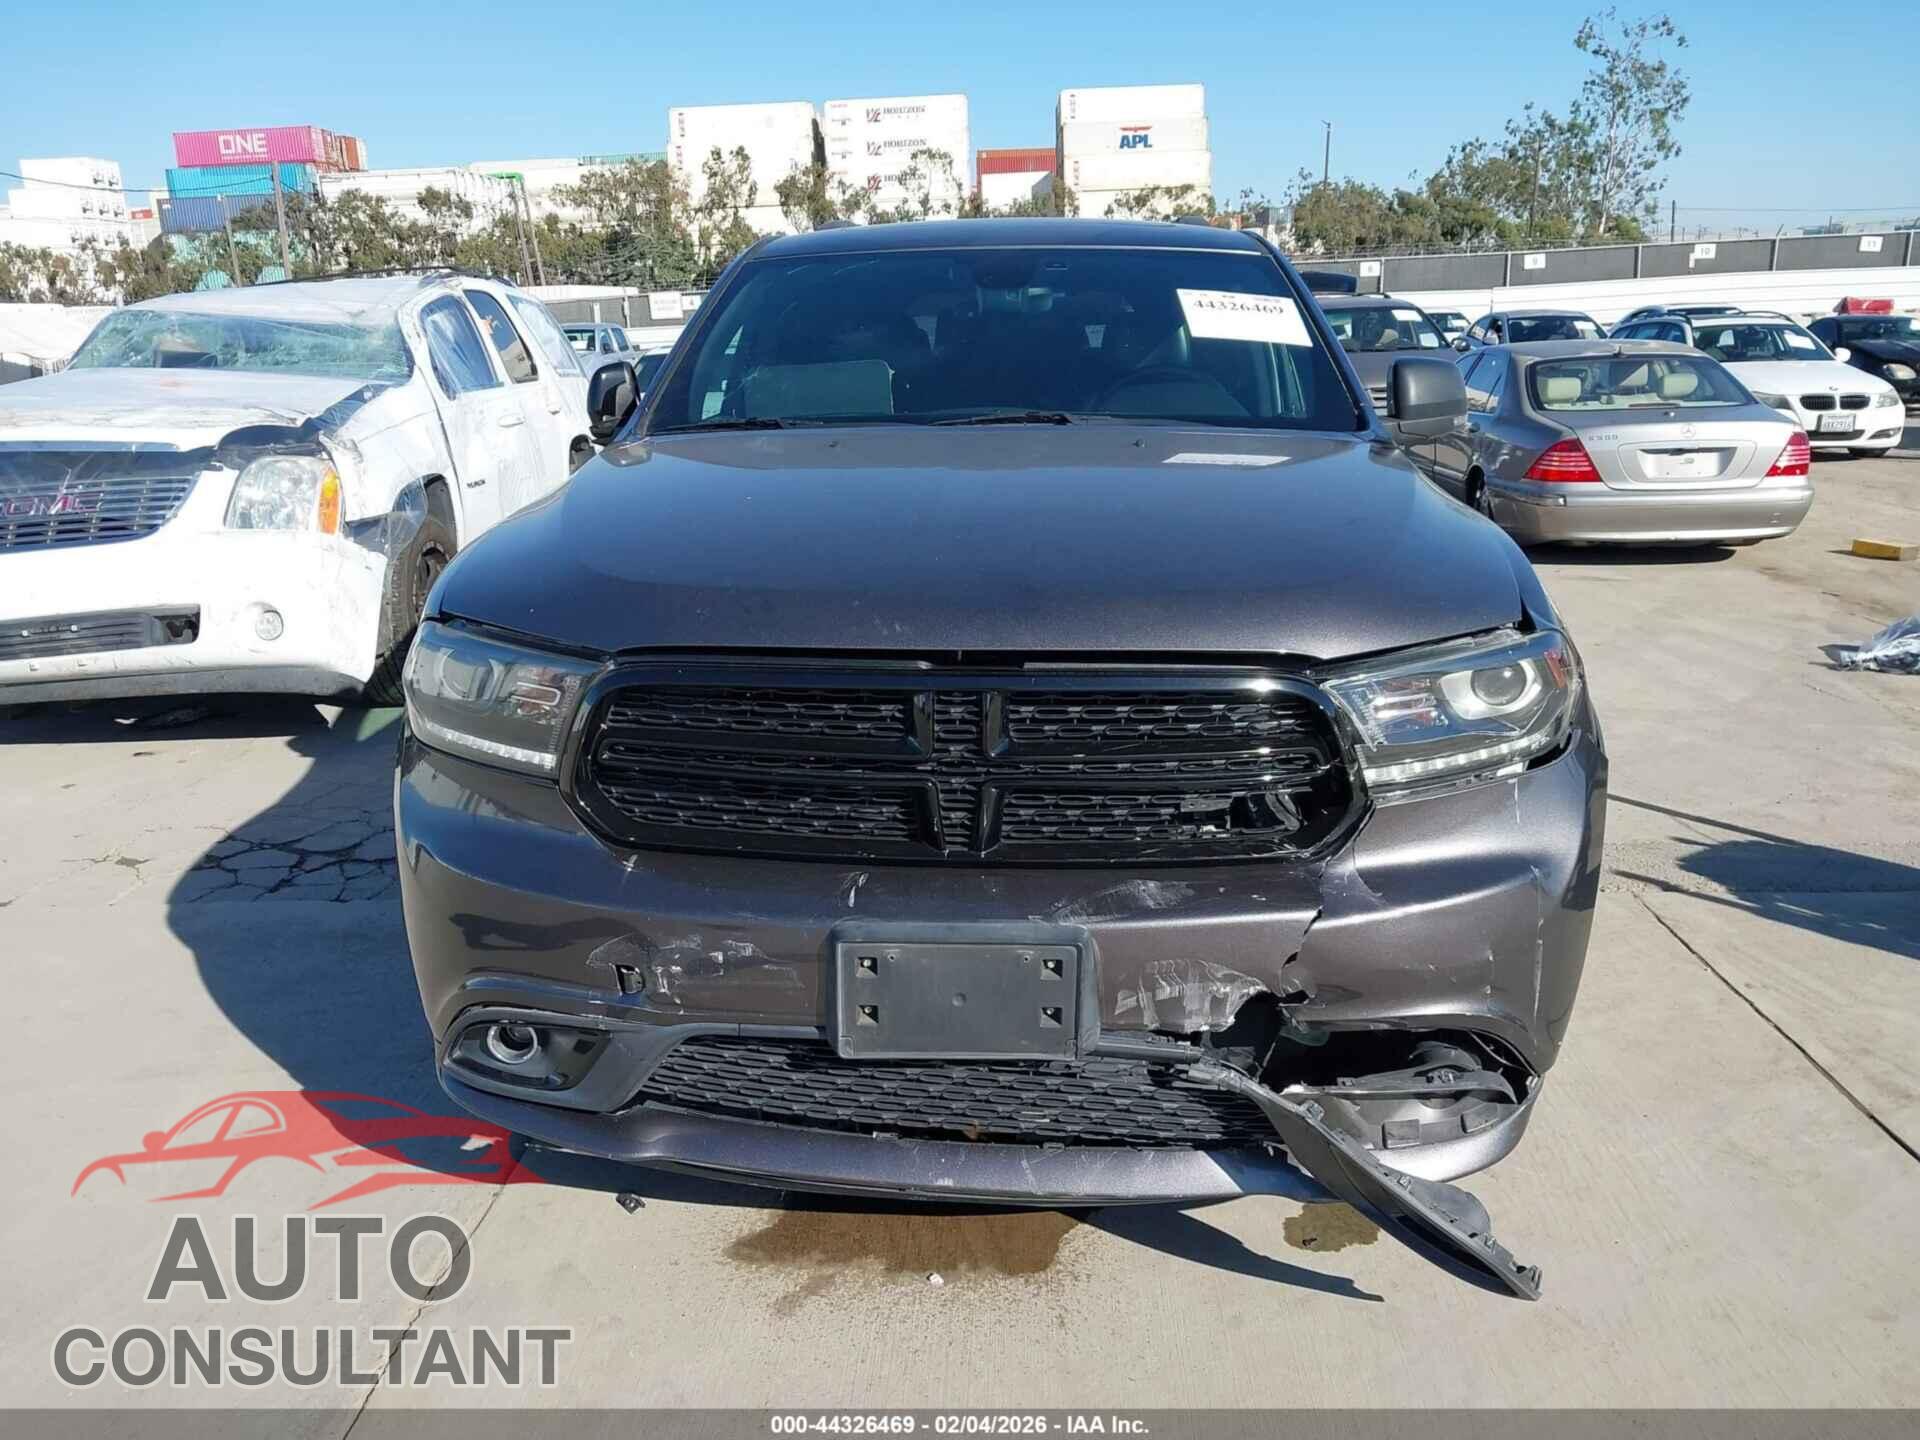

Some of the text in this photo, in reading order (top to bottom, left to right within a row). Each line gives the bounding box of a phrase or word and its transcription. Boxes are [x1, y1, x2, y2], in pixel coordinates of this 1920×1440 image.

[218, 133, 268, 154] ONE
[883, 139, 927, 148] HORIZON
[1119, 134, 1153, 149] APL
[883, 174, 927, 183] HOZON
[1193, 300, 1285, 315] 44326469
